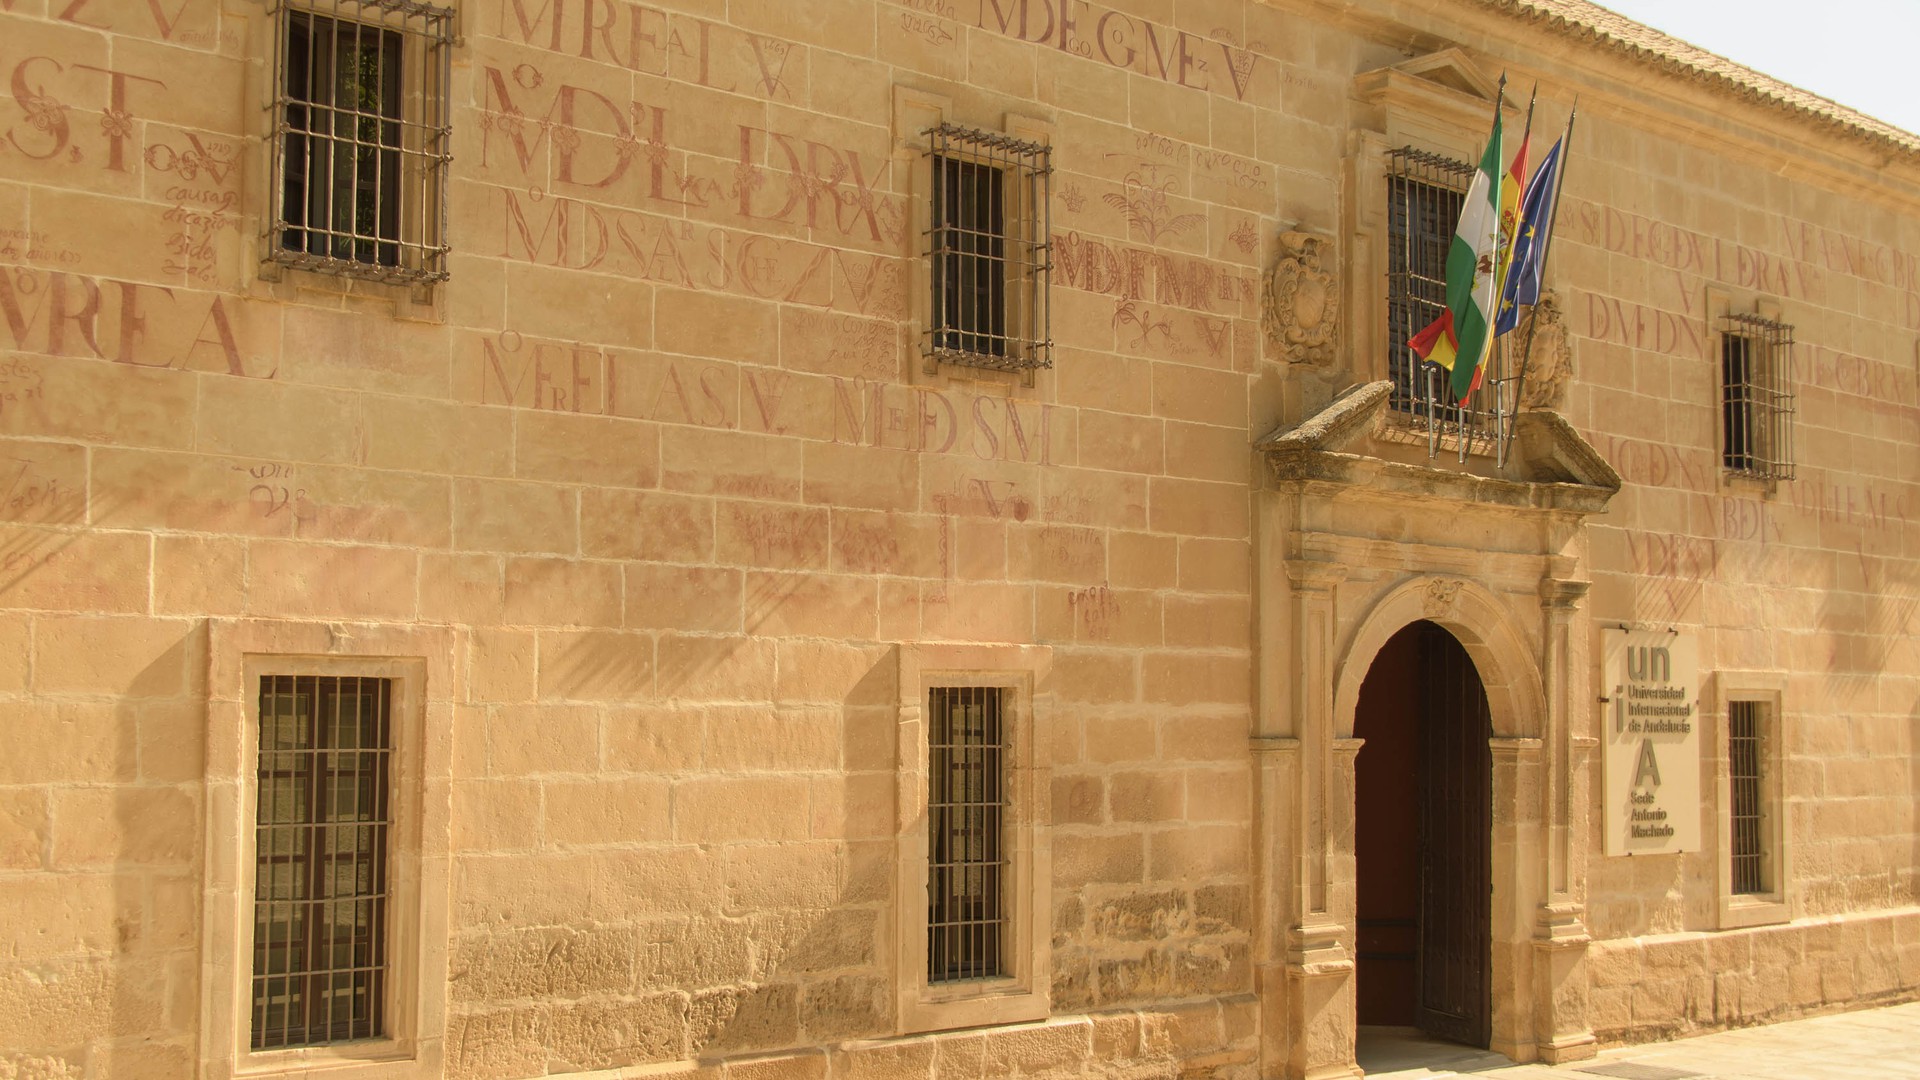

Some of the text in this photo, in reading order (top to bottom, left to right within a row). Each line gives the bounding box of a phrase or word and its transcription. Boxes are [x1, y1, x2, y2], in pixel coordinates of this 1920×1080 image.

[1628, 685, 1685, 699] Universidad
[1628, 702, 1690, 716] Internacional
[1628, 719, 1690, 733] de Andalucía
[1630, 791, 1654, 805] Sede
[1630, 807, 1667, 821] Antonio
[1631, 823, 1674, 838] Machado
